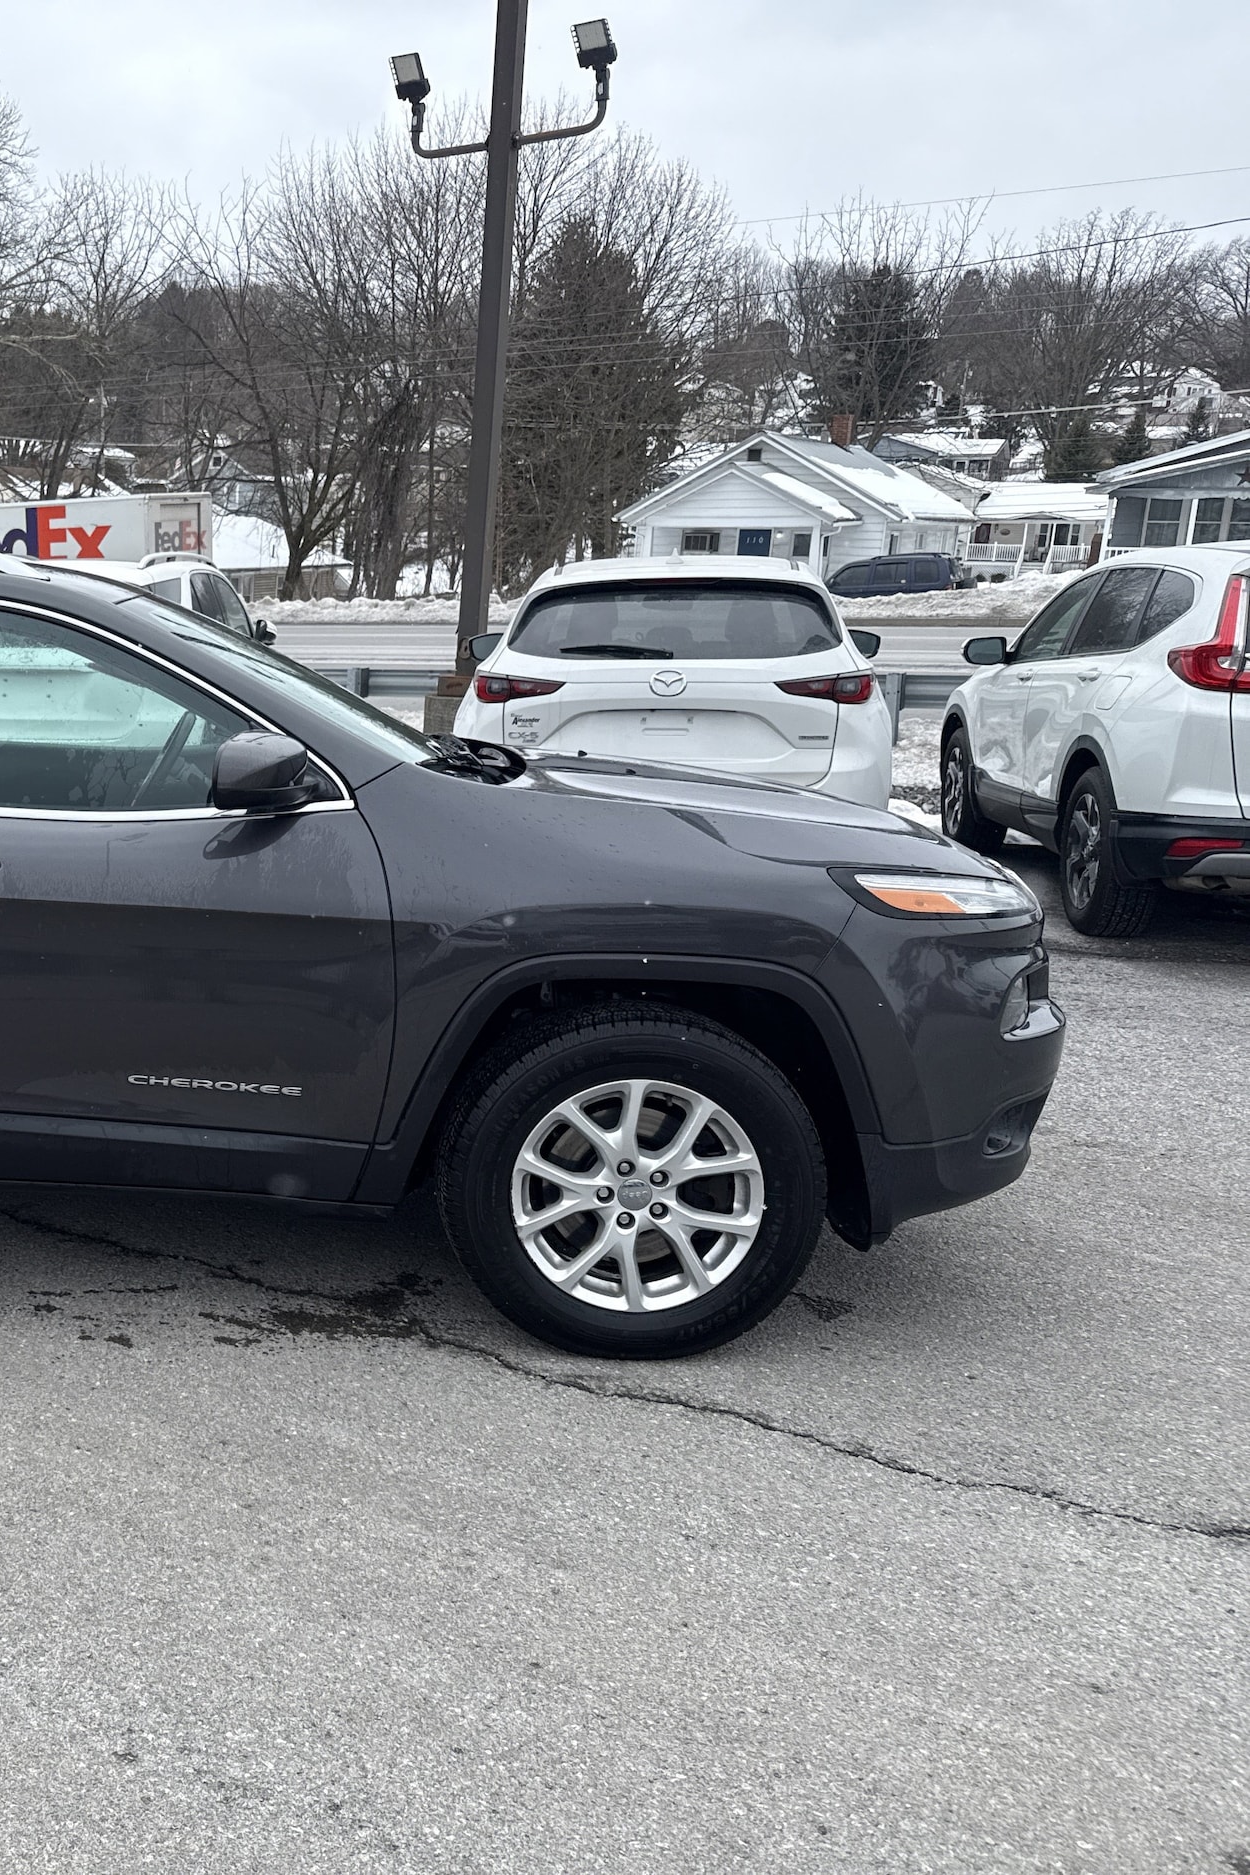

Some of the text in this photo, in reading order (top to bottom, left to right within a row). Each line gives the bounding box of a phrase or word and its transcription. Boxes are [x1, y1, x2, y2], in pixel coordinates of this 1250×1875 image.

[154, 520, 207, 552] FedEx
[508, 731, 539, 739] CX-5
[127, 1074, 303, 1097] CHEROKEE
